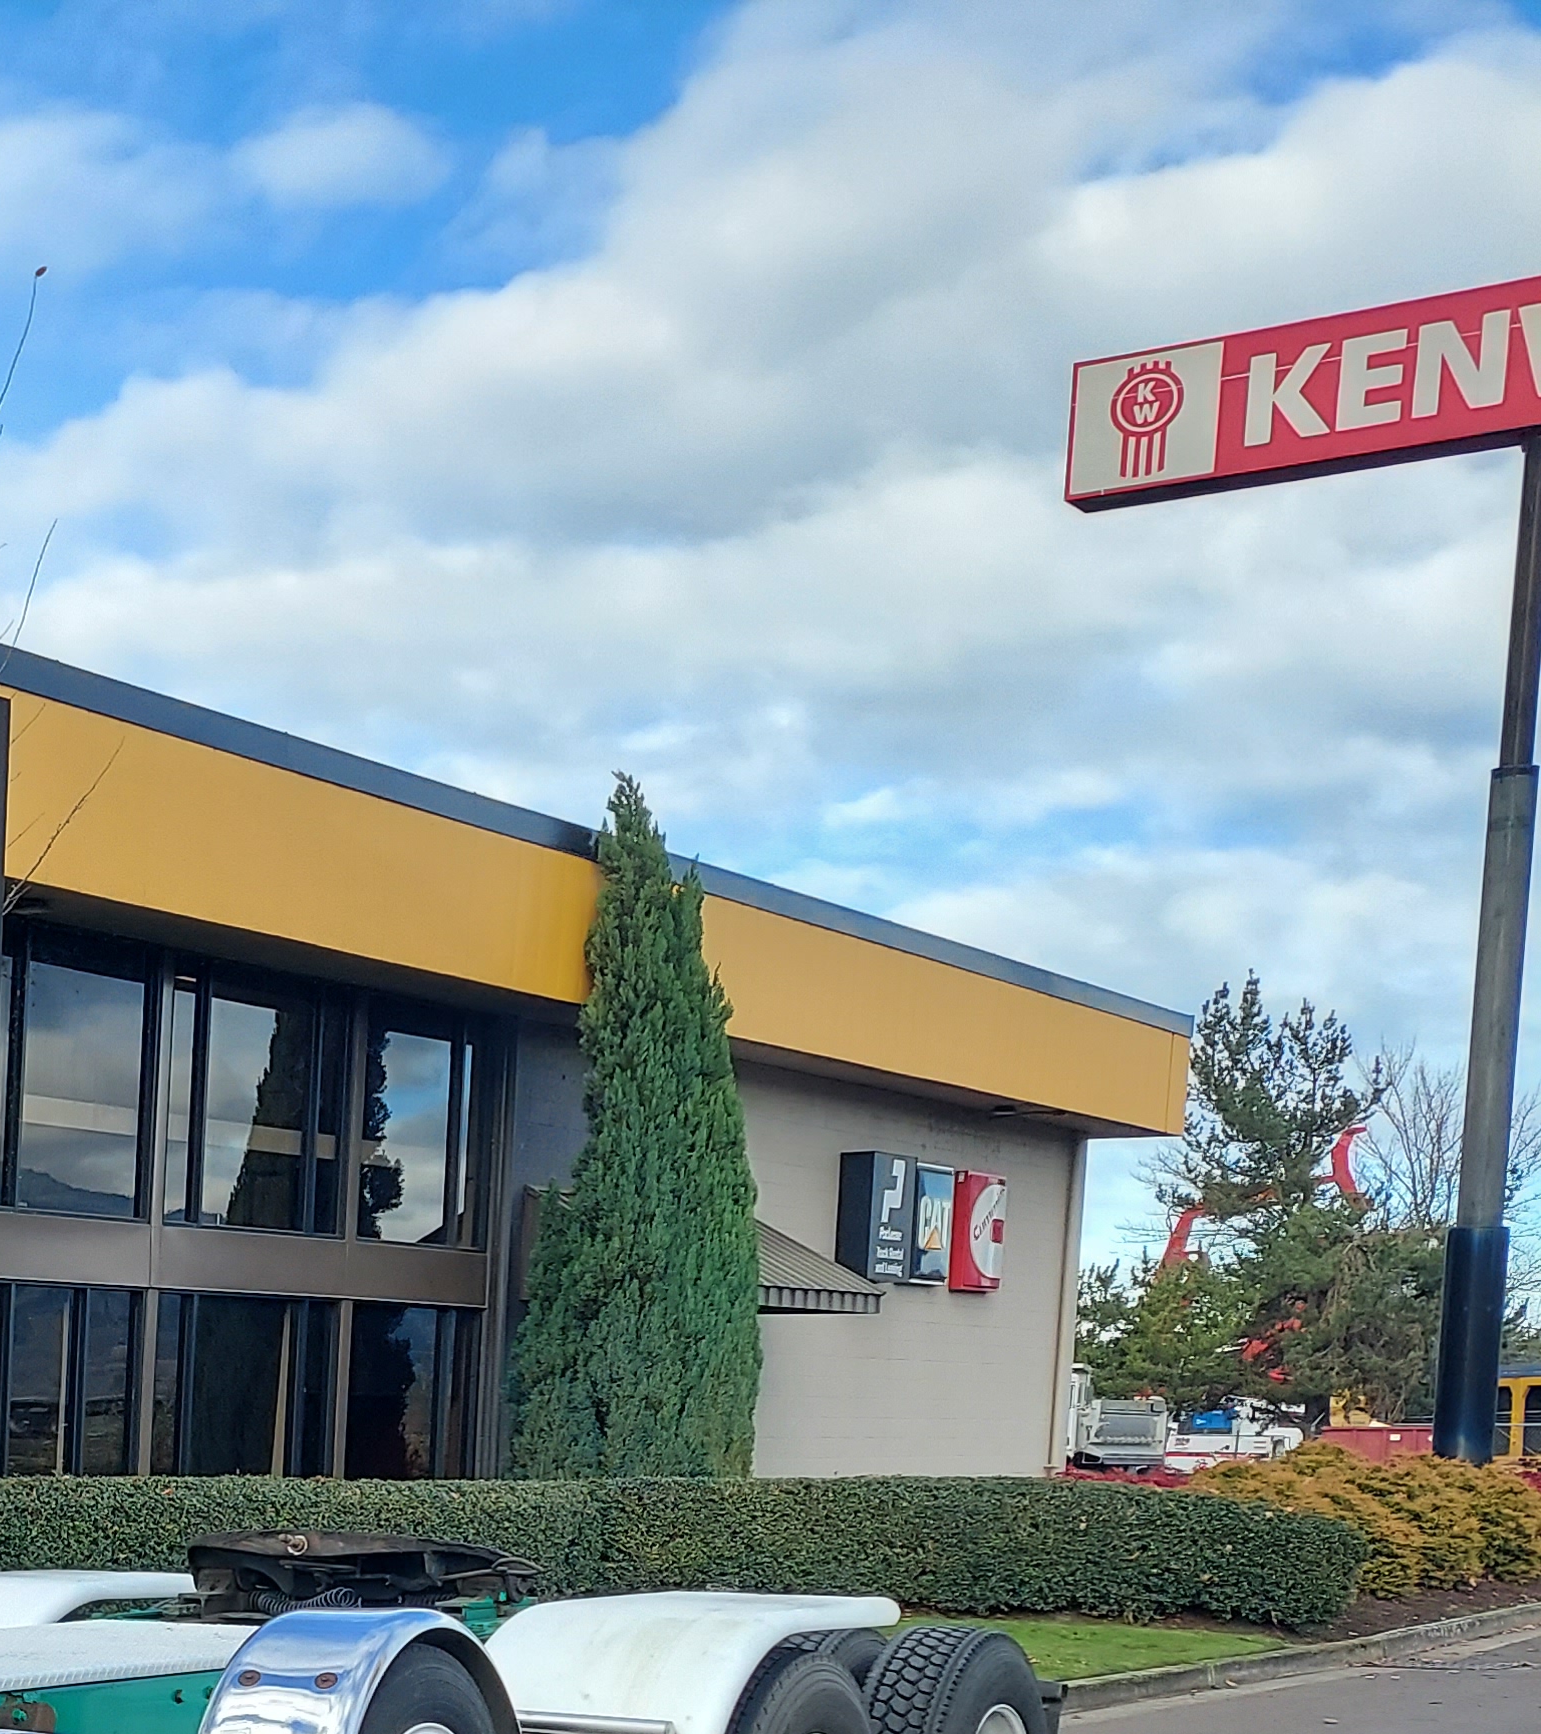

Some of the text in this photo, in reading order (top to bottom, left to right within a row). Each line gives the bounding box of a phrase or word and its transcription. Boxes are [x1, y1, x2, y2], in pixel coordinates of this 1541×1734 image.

[1137, 381, 1157, 403] K
[1243, 302, 1541, 448] KEN
[1133, 403, 1159, 425] W
[919, 1195, 951, 1250] CAT
